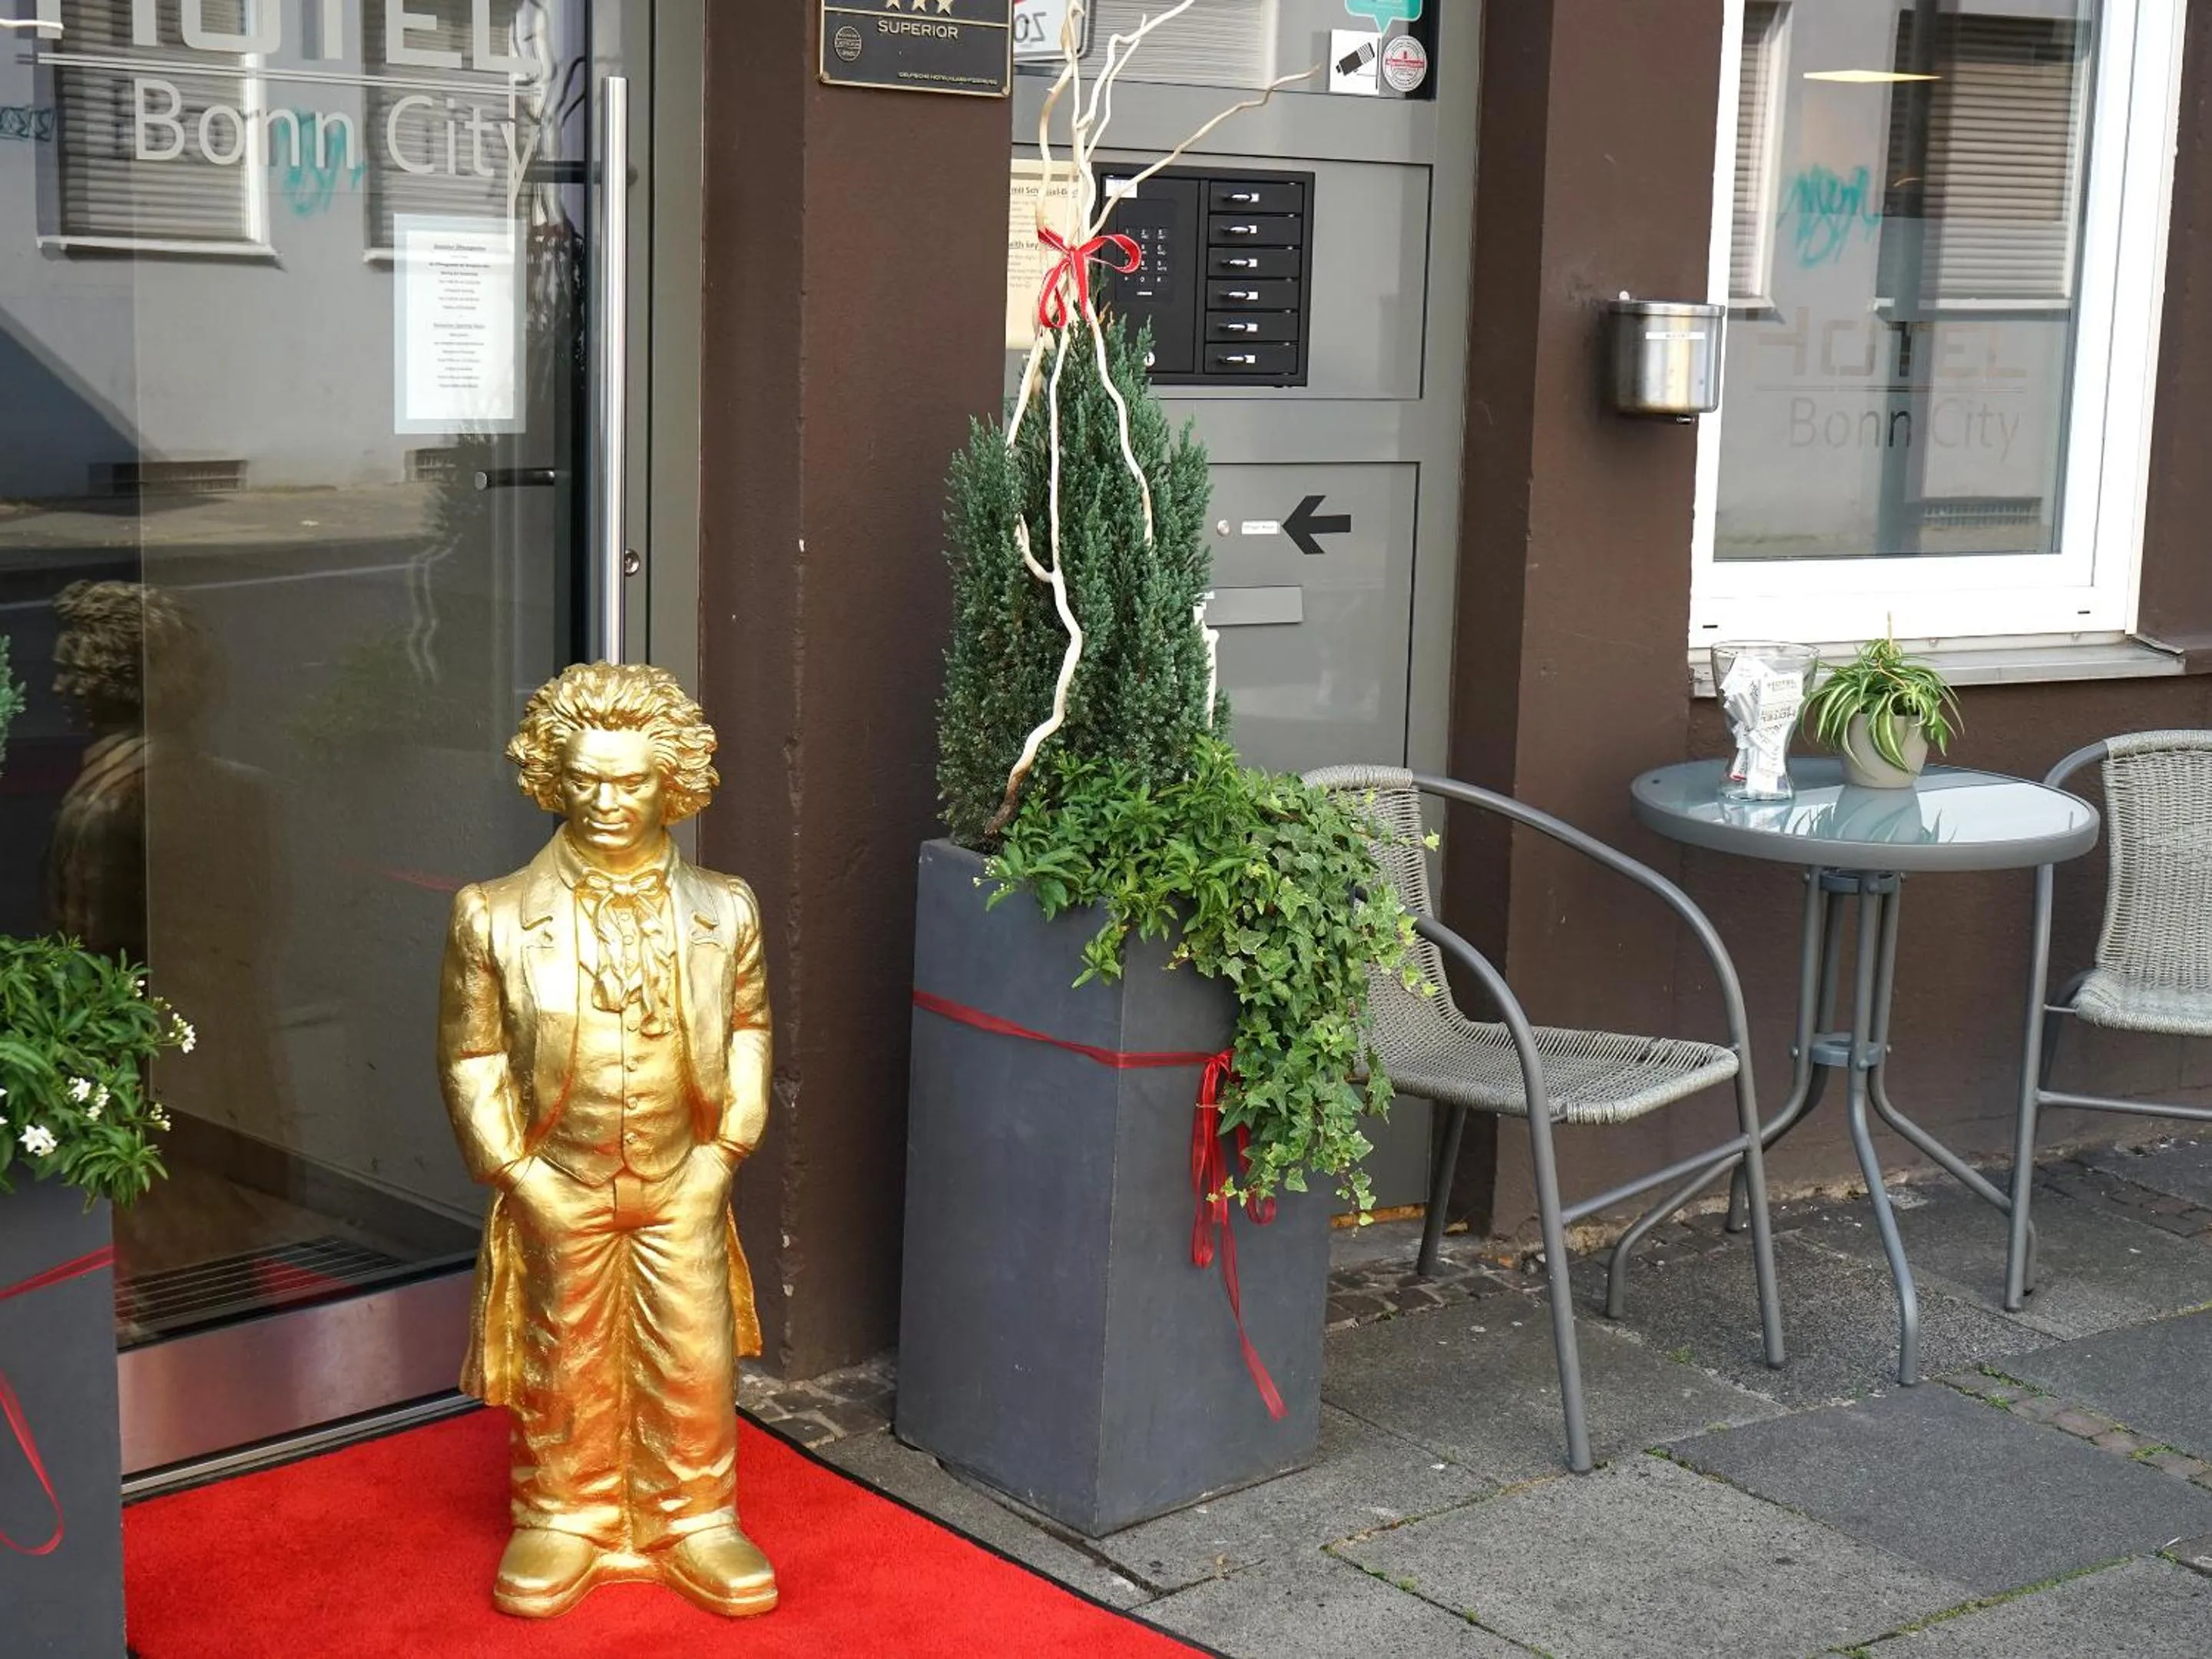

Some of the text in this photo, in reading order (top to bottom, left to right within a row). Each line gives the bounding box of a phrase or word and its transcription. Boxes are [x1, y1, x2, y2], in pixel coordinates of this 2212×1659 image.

[878, 19, 959, 38] SUPERIOR
[134, 78, 356, 170] Bonn
[387, 94, 541, 201] City
[1745, 307, 2028, 378] HOTEL
[1788, 397, 2021, 462] Bonn City
